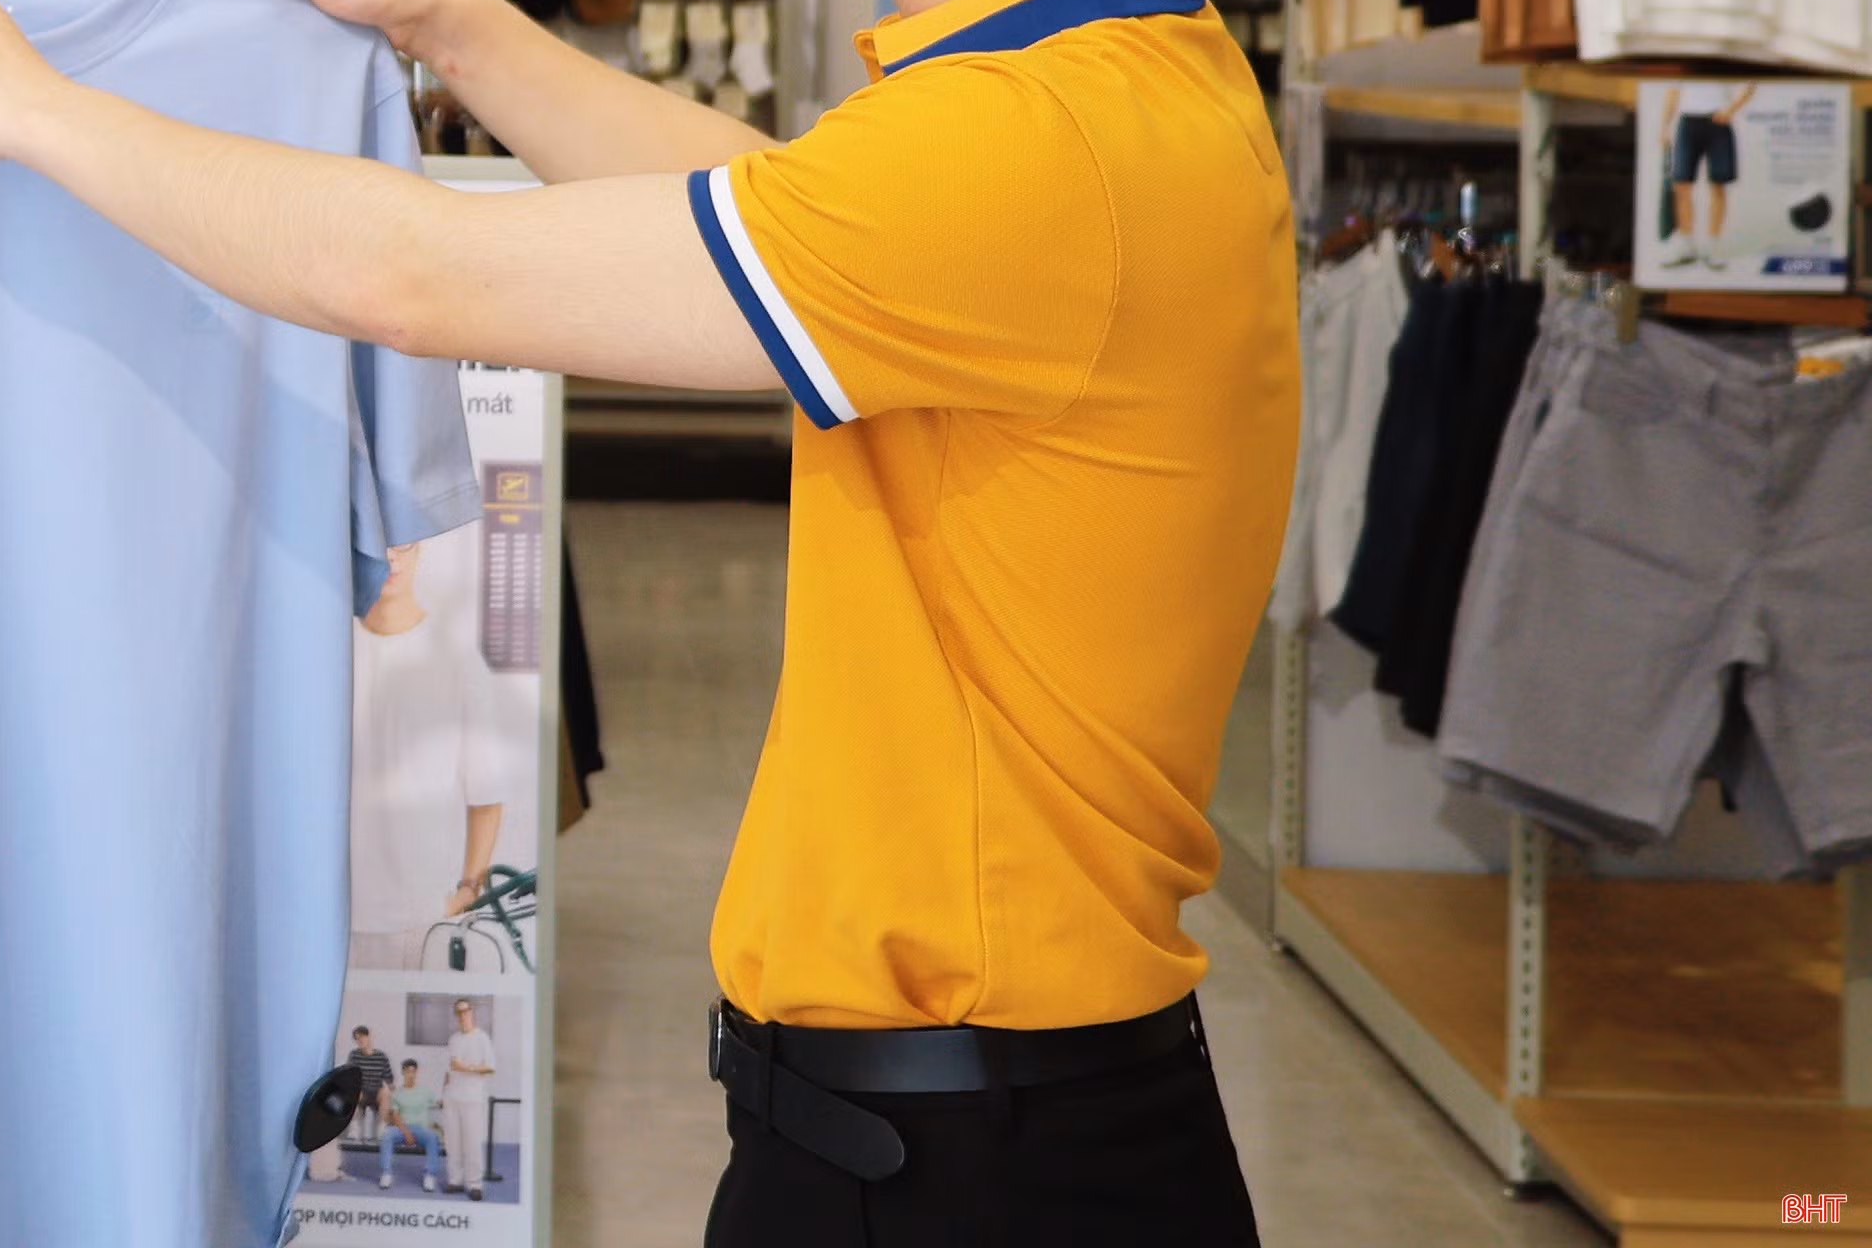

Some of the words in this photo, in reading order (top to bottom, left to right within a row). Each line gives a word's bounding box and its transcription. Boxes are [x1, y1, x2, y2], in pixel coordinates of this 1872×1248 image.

[467, 391, 513, 414] mát
[319, 1210, 354, 1228] MỌI
[358, 1210, 419, 1228] PHONG
[423, 1211, 469, 1229] CÁCH
